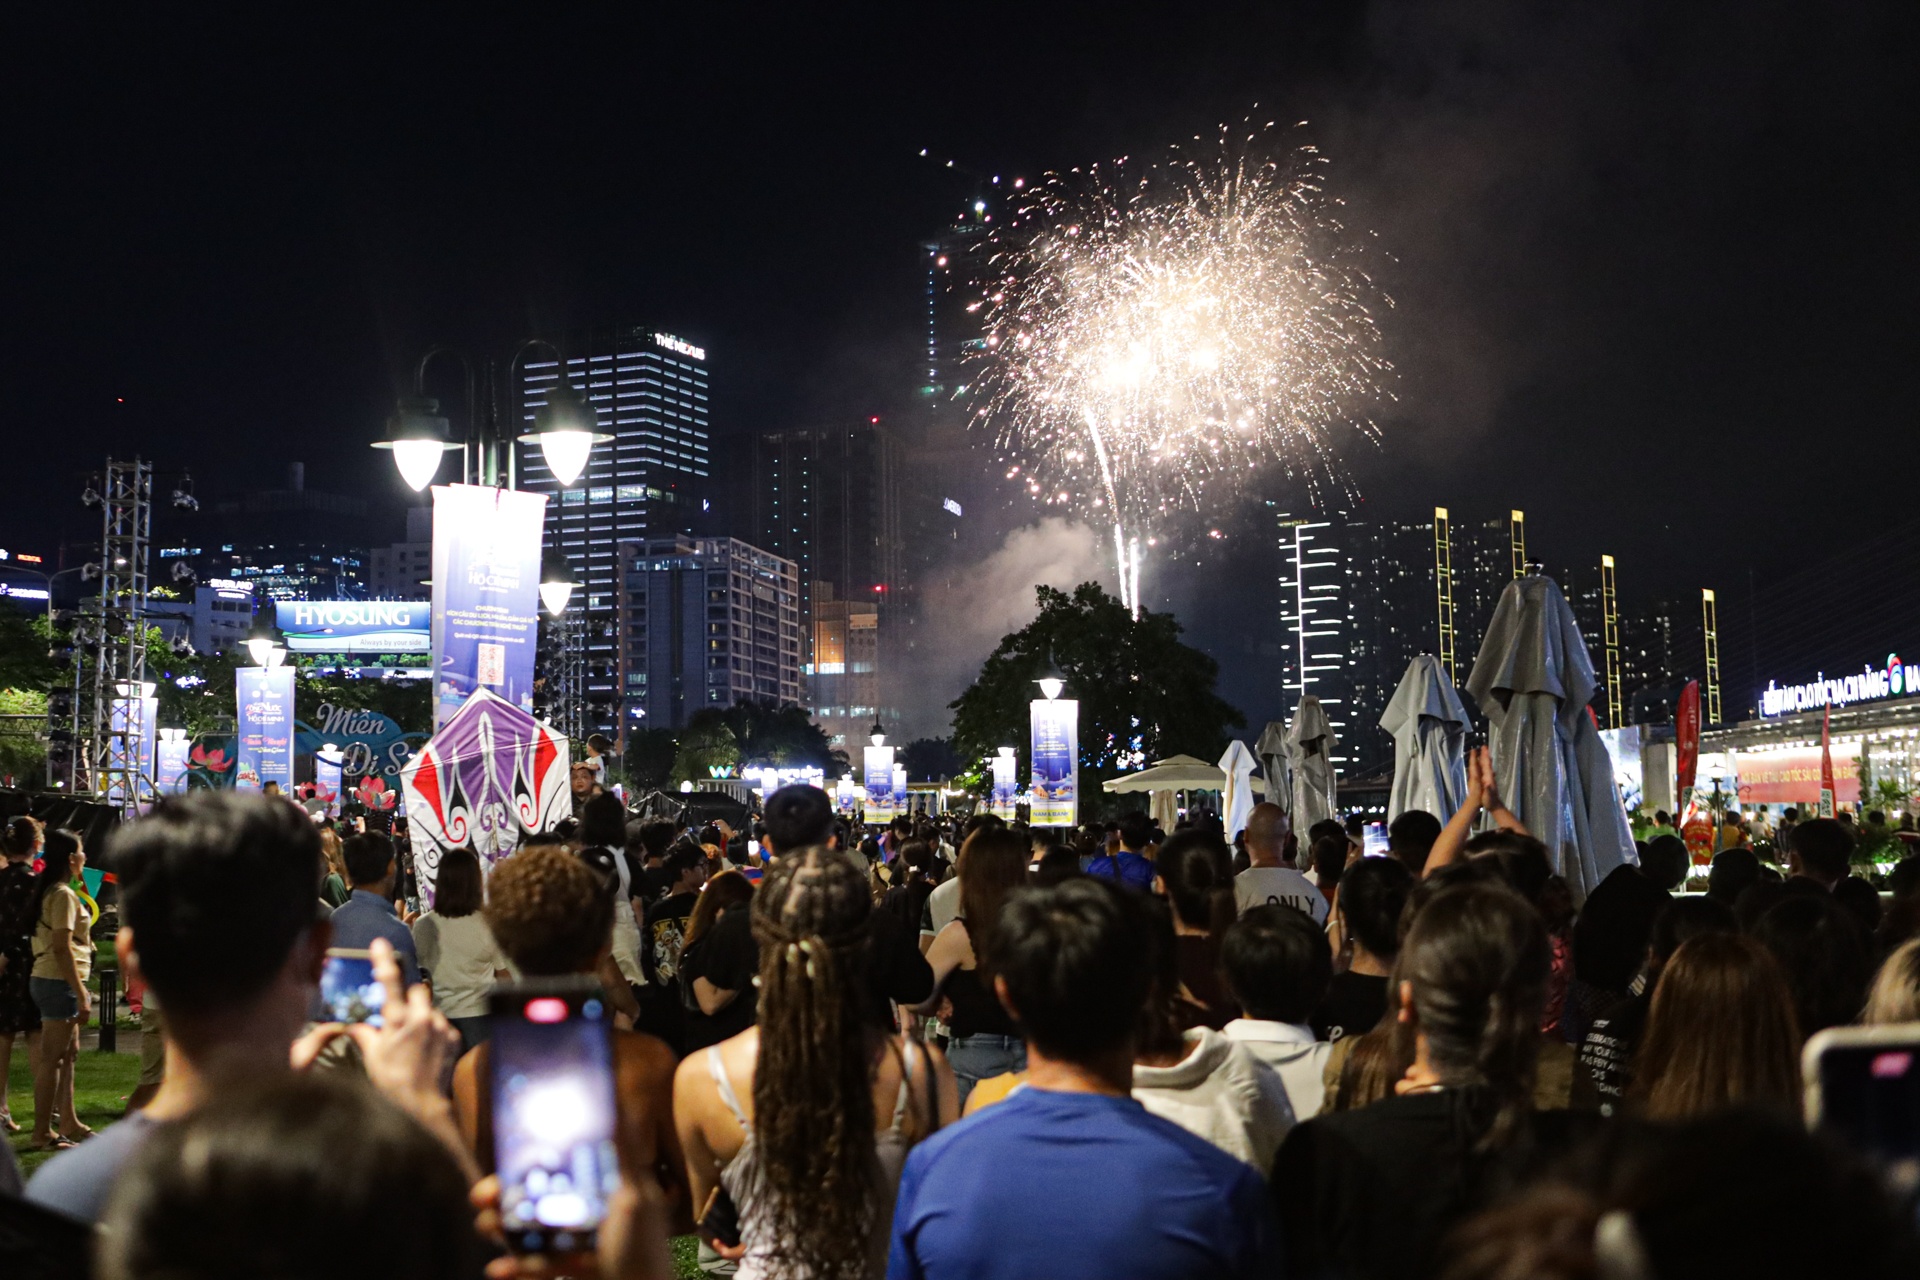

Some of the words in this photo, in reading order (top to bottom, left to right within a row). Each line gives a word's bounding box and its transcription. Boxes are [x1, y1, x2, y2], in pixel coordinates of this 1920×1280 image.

[654, 332, 675, 350] THE
[674, 340, 706, 361] NEXUS
[294, 605, 411, 626] HYOSUNG
[360, 638, 383, 647] Always
[384, 638, 392, 647] by
[393, 639, 407, 647] your
[409, 638, 422, 646] side
[1794, 683, 1814, 709] CAO
[1830, 675, 1859, 709] BẠCH
[342, 741, 380, 777] Di
